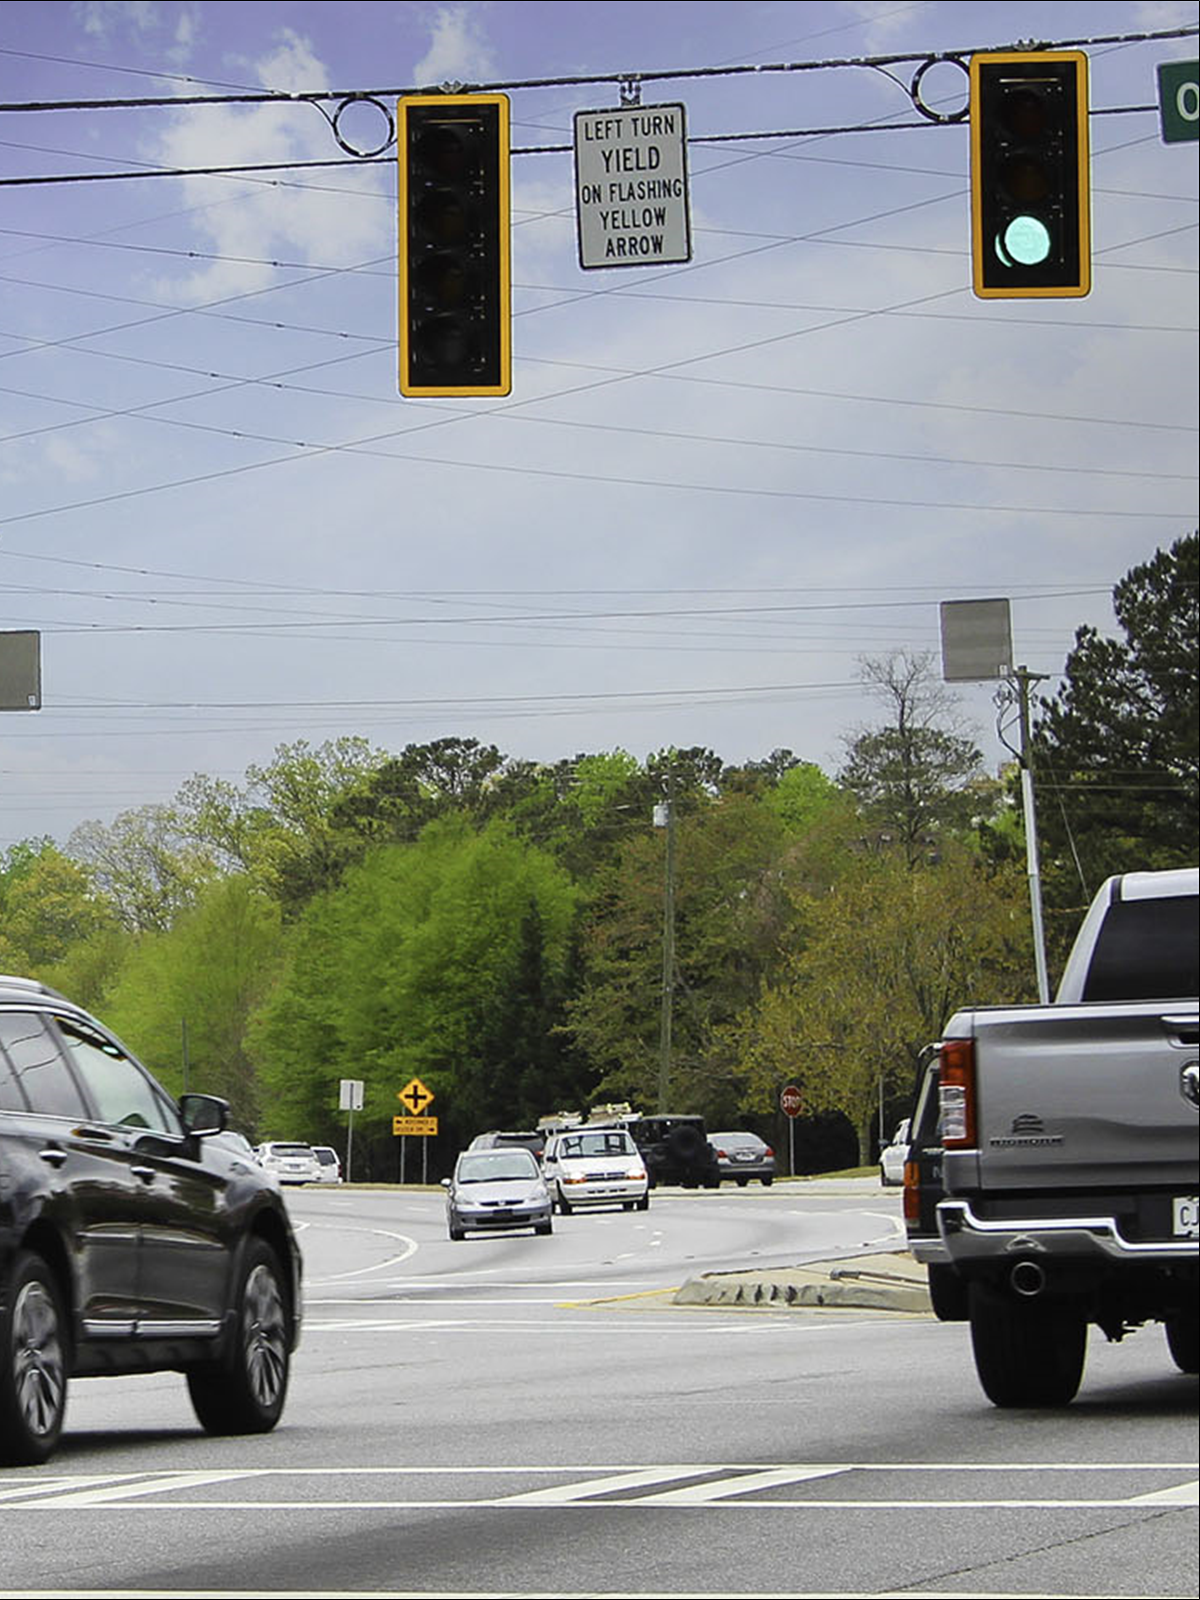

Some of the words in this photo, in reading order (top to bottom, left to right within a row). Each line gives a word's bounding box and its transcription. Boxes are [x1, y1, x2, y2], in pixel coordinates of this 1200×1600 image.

[585, 119, 623, 141] LEFT
[631, 115, 675, 136] TURN
[602, 146, 660, 173] YIELD
[582, 184, 601, 204] ON
[609, 179, 682, 202] FLASHING
[600, 207, 667, 230] YELLOW
[605, 235, 664, 257] ARROW
